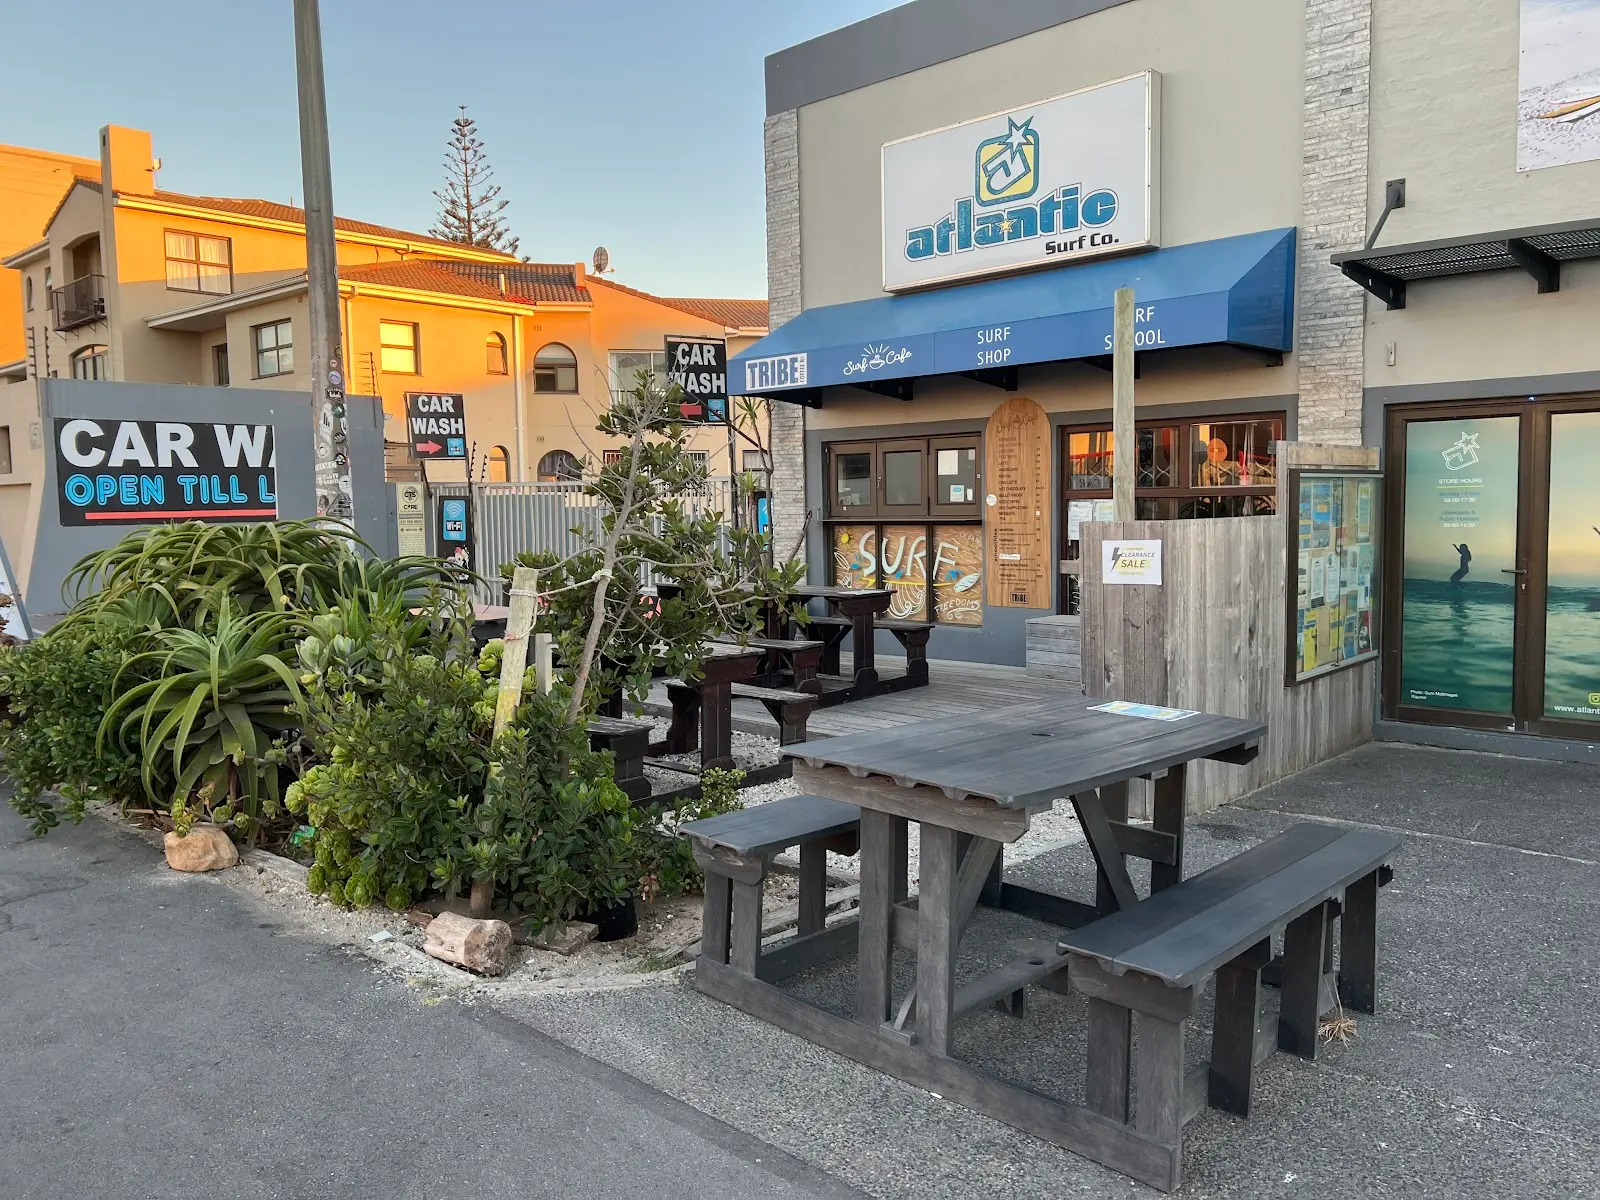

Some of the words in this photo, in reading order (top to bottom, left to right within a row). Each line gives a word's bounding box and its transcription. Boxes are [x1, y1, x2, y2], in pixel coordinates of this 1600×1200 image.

[904, 182, 1119, 262] atlantic
[1045, 234, 1087, 254] Surf
[1090, 232, 1120, 247] Co.
[977, 327, 1011, 344] SURF
[1104, 329, 1166, 350] SOOL
[677, 343, 717, 365] CAR
[977, 348, 1011, 366] SHOP
[748, 357, 799, 388] TRIBE
[843, 357, 868, 376] Surf
[417, 395, 455, 413] CAR
[411, 417, 464, 435] WASH
[60, 419, 199, 468] CAR
[213, 424, 275, 468] W
[65, 473, 165, 507] OPEN
[177, 474, 248, 505] TILL
[446, 521, 463, 531] Wi-Fi
[859, 530, 960, 581] SURF
[1120, 559, 1147, 568] SALE
